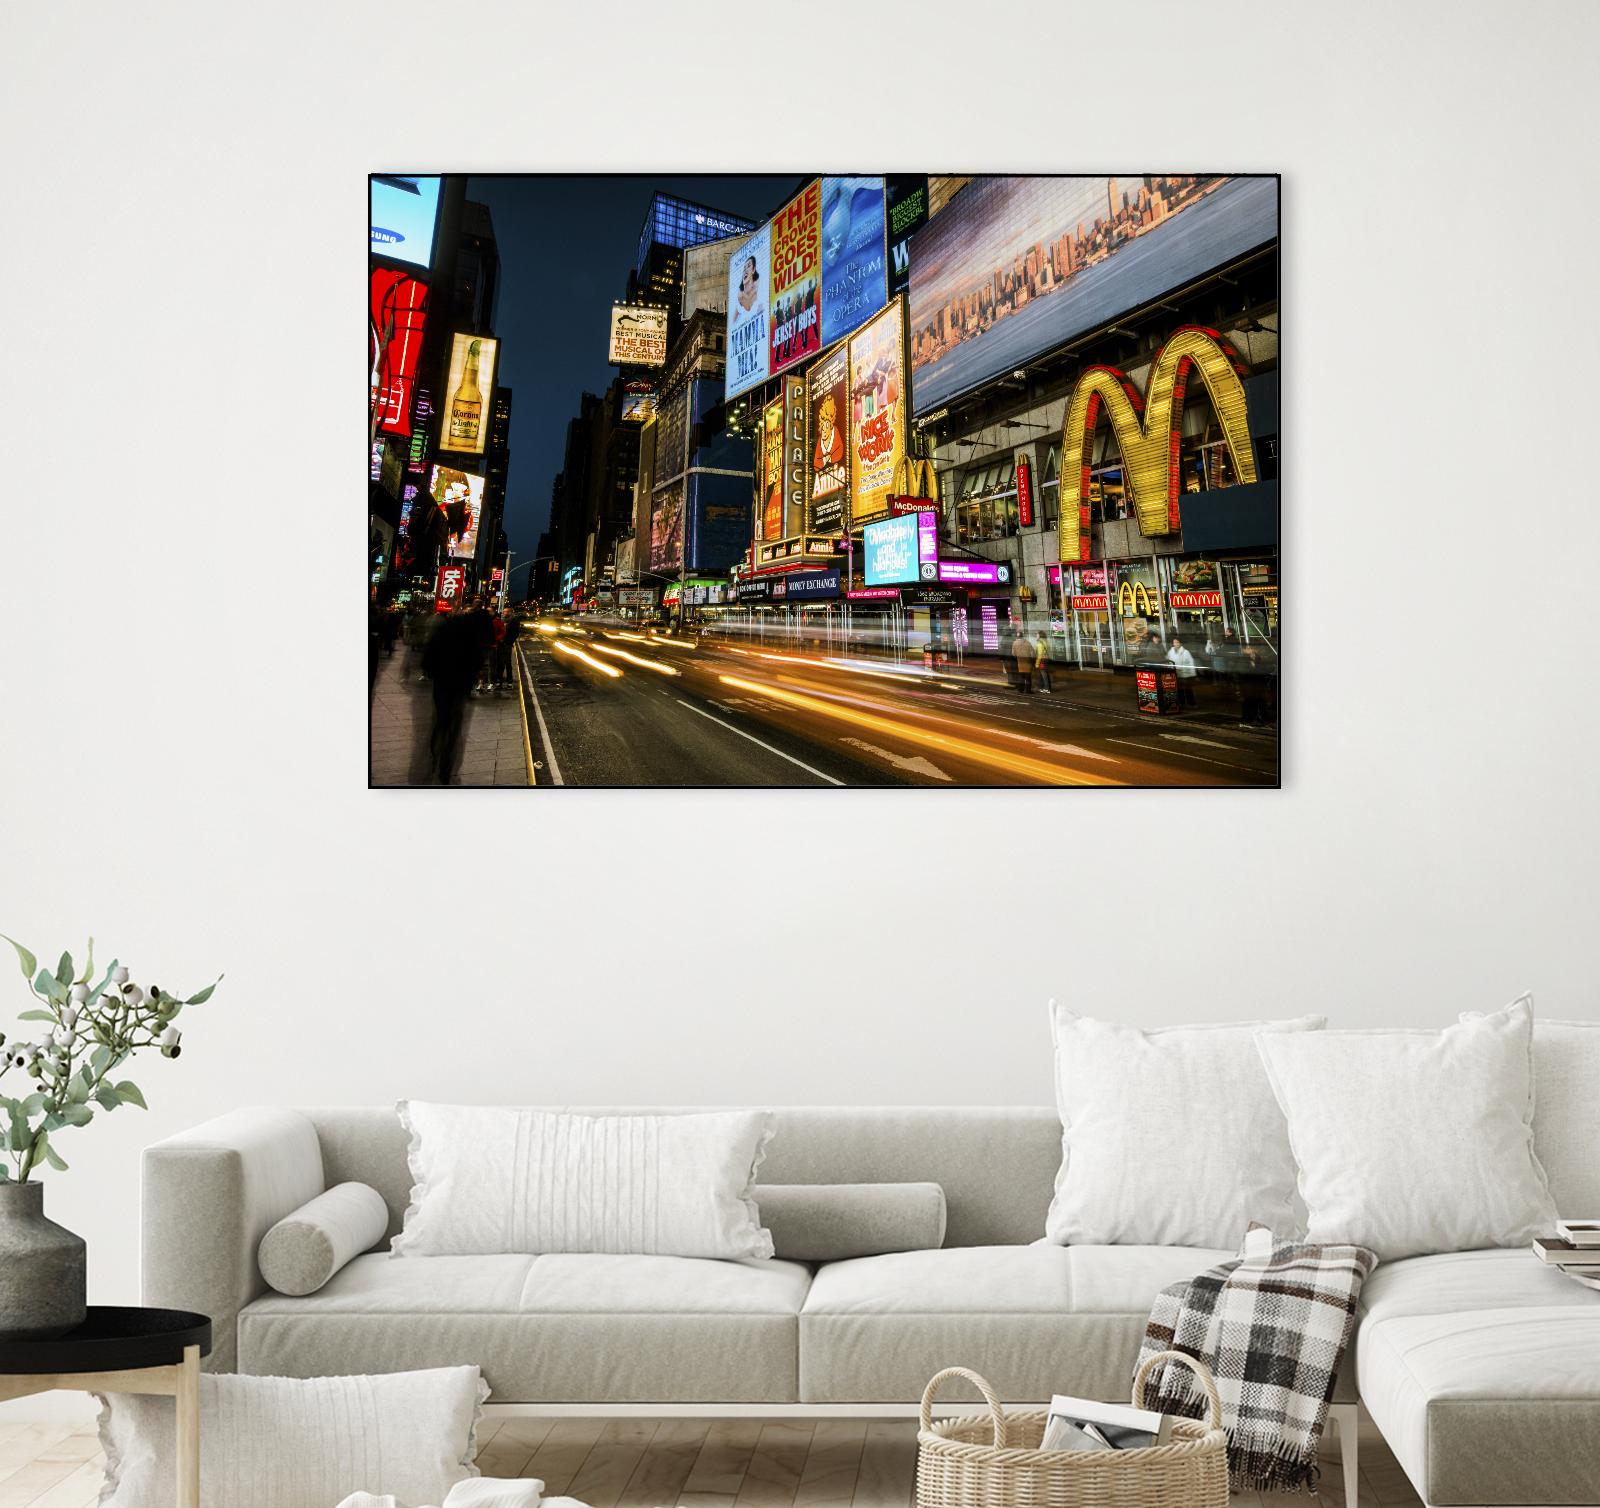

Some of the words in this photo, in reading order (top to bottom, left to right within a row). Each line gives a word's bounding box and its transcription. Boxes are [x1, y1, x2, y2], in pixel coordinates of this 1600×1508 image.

[773, 184, 818, 239] THE
[773, 211, 818, 256] CROWD
[773, 227, 817, 274] GOES
[773, 247, 818, 294] WILD!
[826, 256, 881, 301] PHANTOM
[832, 292, 870, 322] OPERA
[615, 337, 638, 347] THE
[639, 339, 667, 349] BEST
[635, 332, 666, 341] MUSICAL
[730, 315, 766, 359] MAMMA
[772, 316, 798, 348] JERSEY
[798, 304, 817, 332] BOYS
[614, 345, 653, 355] MUSICAL
[654, 348, 667, 356] OF
[632, 352, 665, 361] CENTURY
[861, 409, 889, 443] NICE
[857, 429, 895, 463] WORK
[812, 463, 846, 500] Annie
[809, 539, 835, 553] Annie
[442, 569, 461, 599] tkts
[788, 580, 806, 592] MONEY
[806, 577, 837, 591] EXCHANGE
